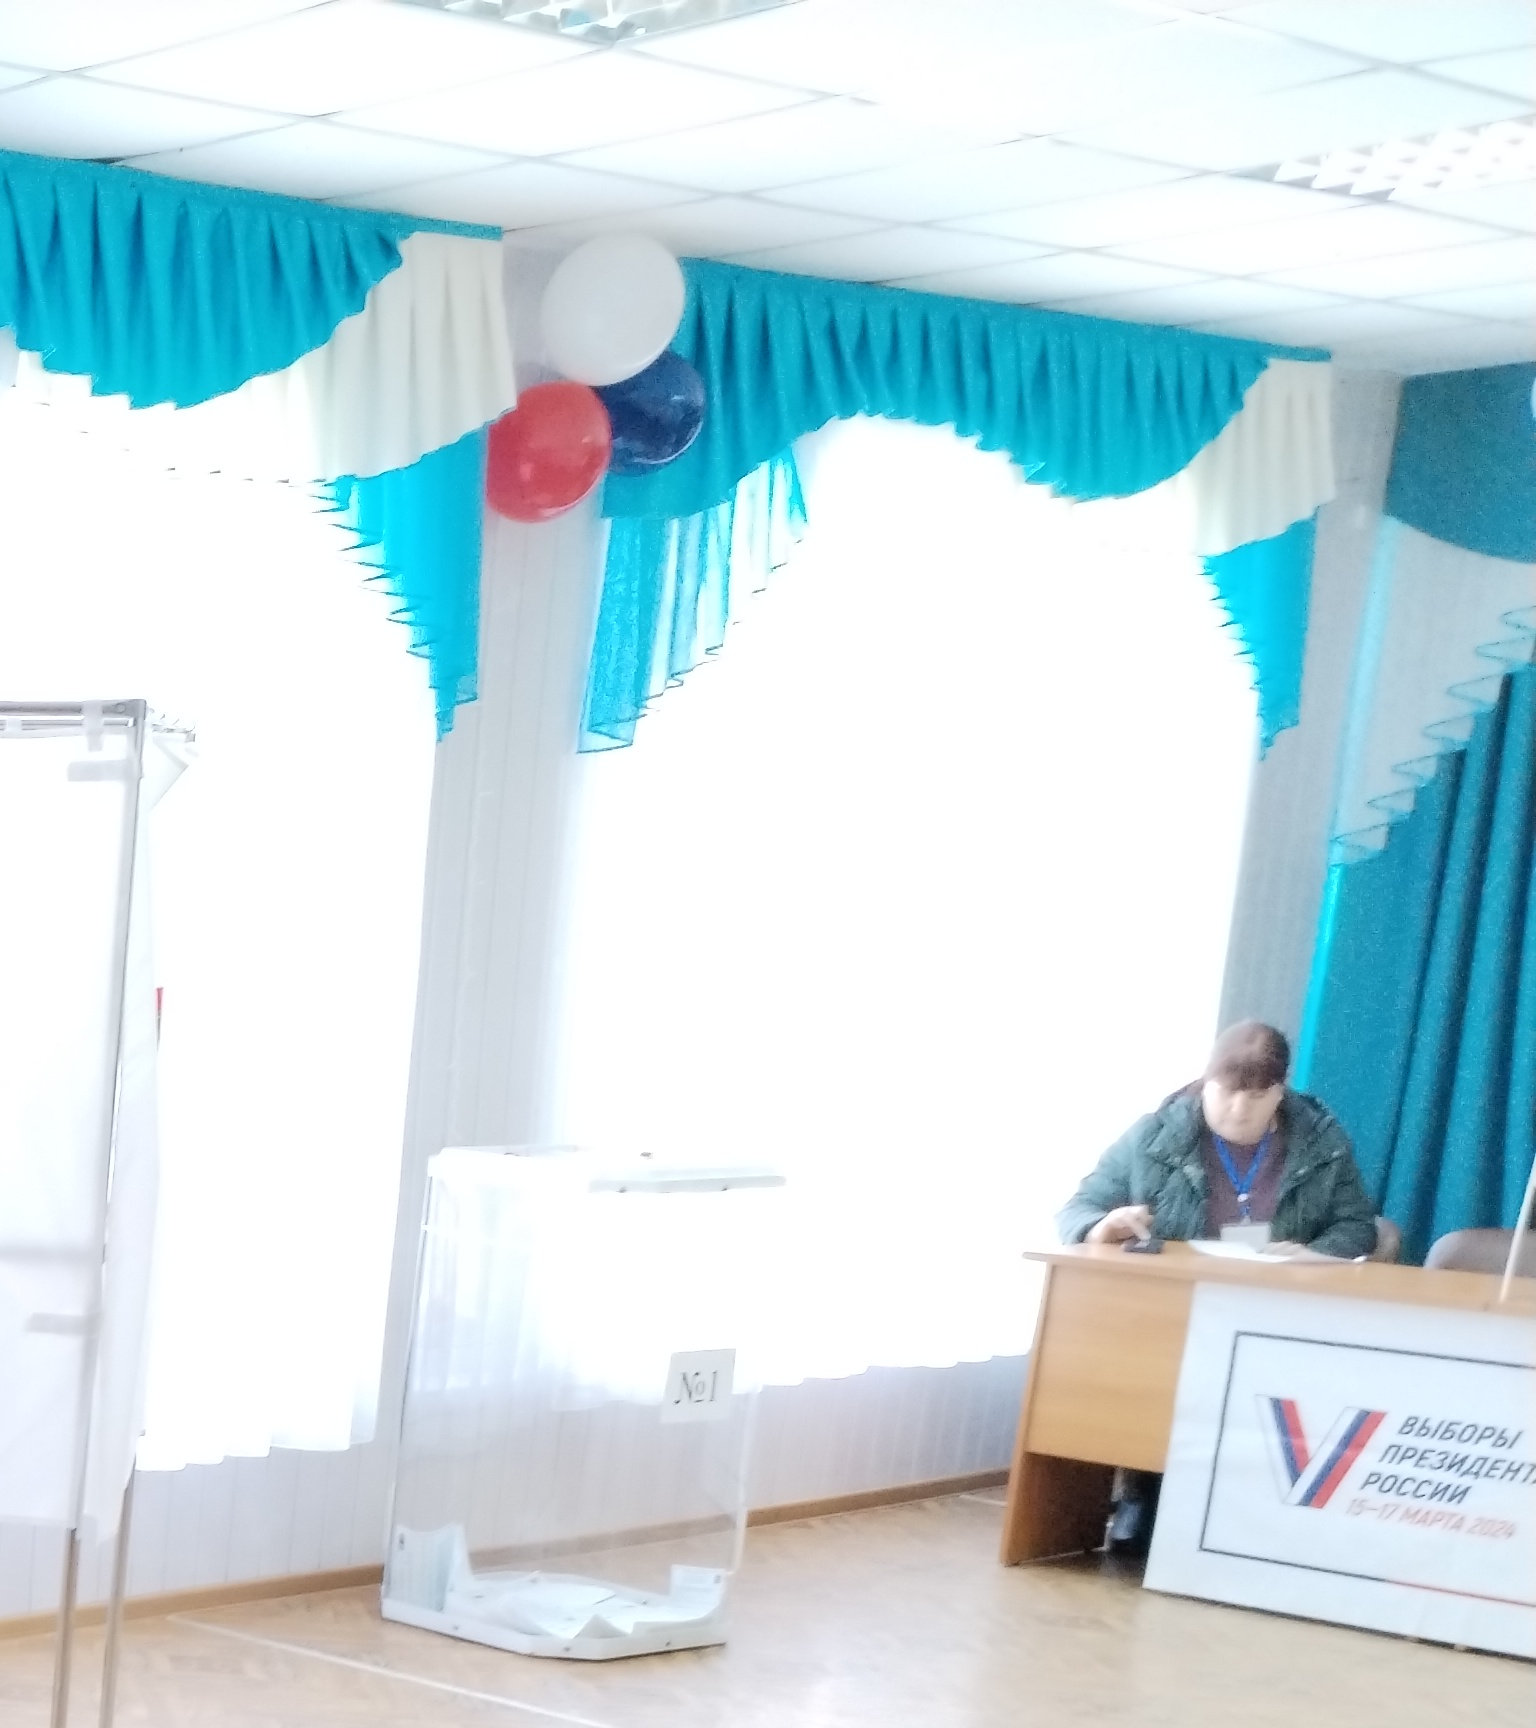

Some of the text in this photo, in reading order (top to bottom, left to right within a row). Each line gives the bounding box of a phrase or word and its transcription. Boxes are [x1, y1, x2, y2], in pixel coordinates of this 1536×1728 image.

[1398, 1415, 1524, 1449] ВЫБОРЫ
[1359, 1471, 1473, 1504] РОССИИ
[1399, 1507, 1466, 1531] МАРТА
